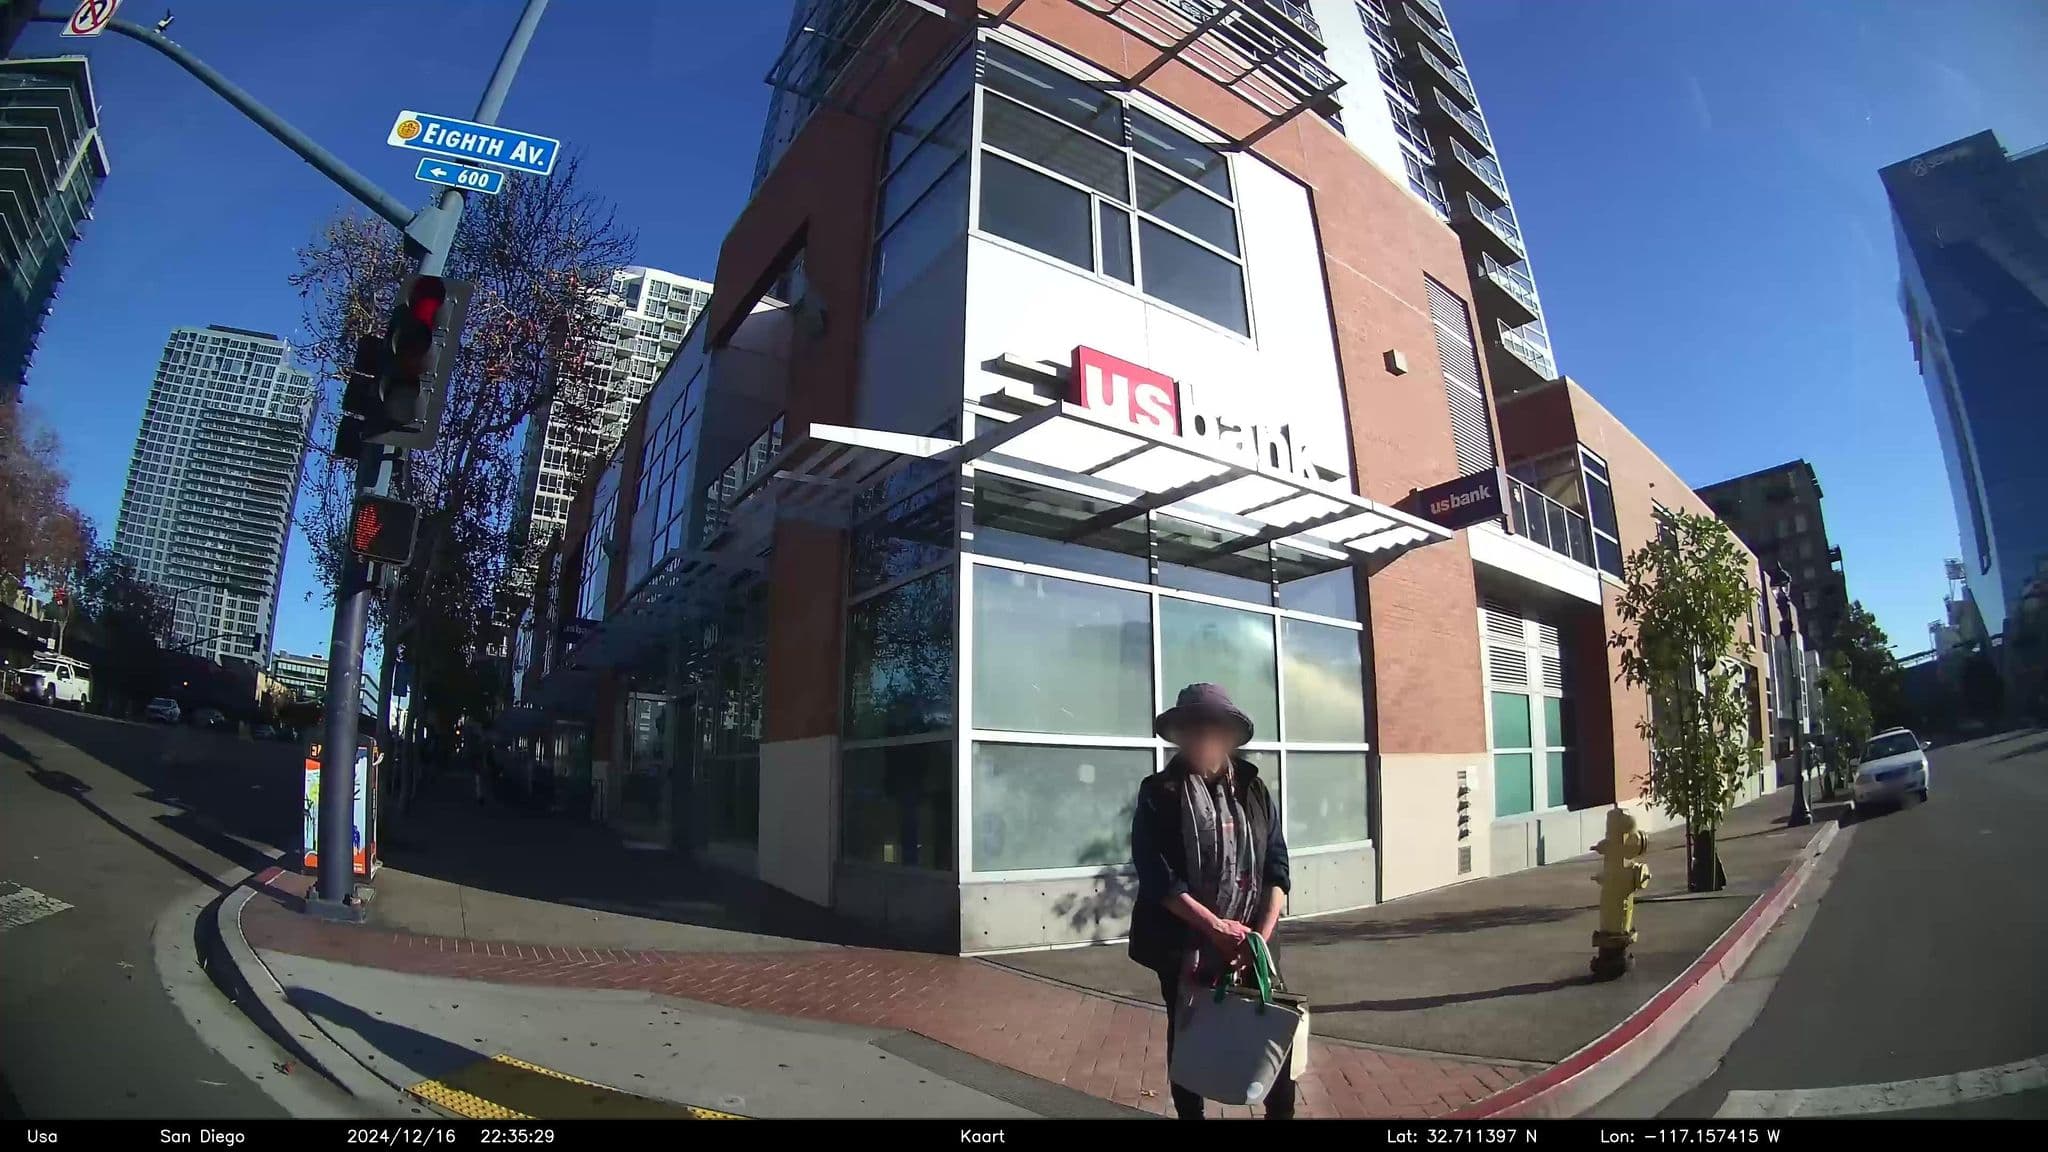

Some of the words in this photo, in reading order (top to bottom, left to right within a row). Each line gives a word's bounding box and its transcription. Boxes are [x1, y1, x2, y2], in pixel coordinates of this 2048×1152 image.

[422, 122, 504, 157] EIGHTH
[509, 140, 545, 167] AV.
[457, 169, 489, 188] 600
